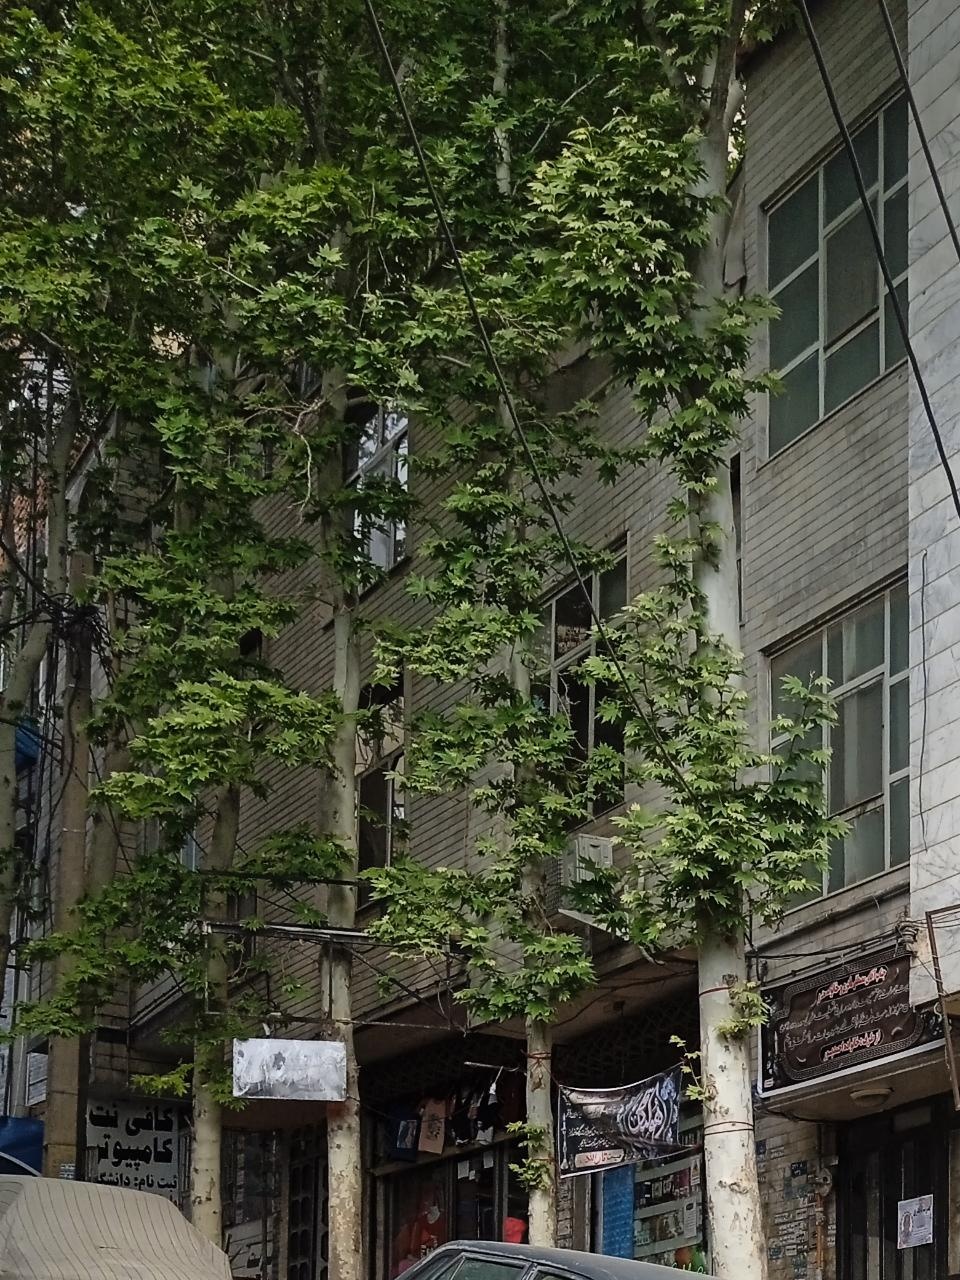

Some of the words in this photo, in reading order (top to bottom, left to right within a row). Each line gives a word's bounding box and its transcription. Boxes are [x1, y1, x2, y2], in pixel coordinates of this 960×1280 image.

[89, 1103, 119, 1129] نت
[125, 1104, 174, 1137] کافی
[156, 1173, 178, 1192] ثبت
